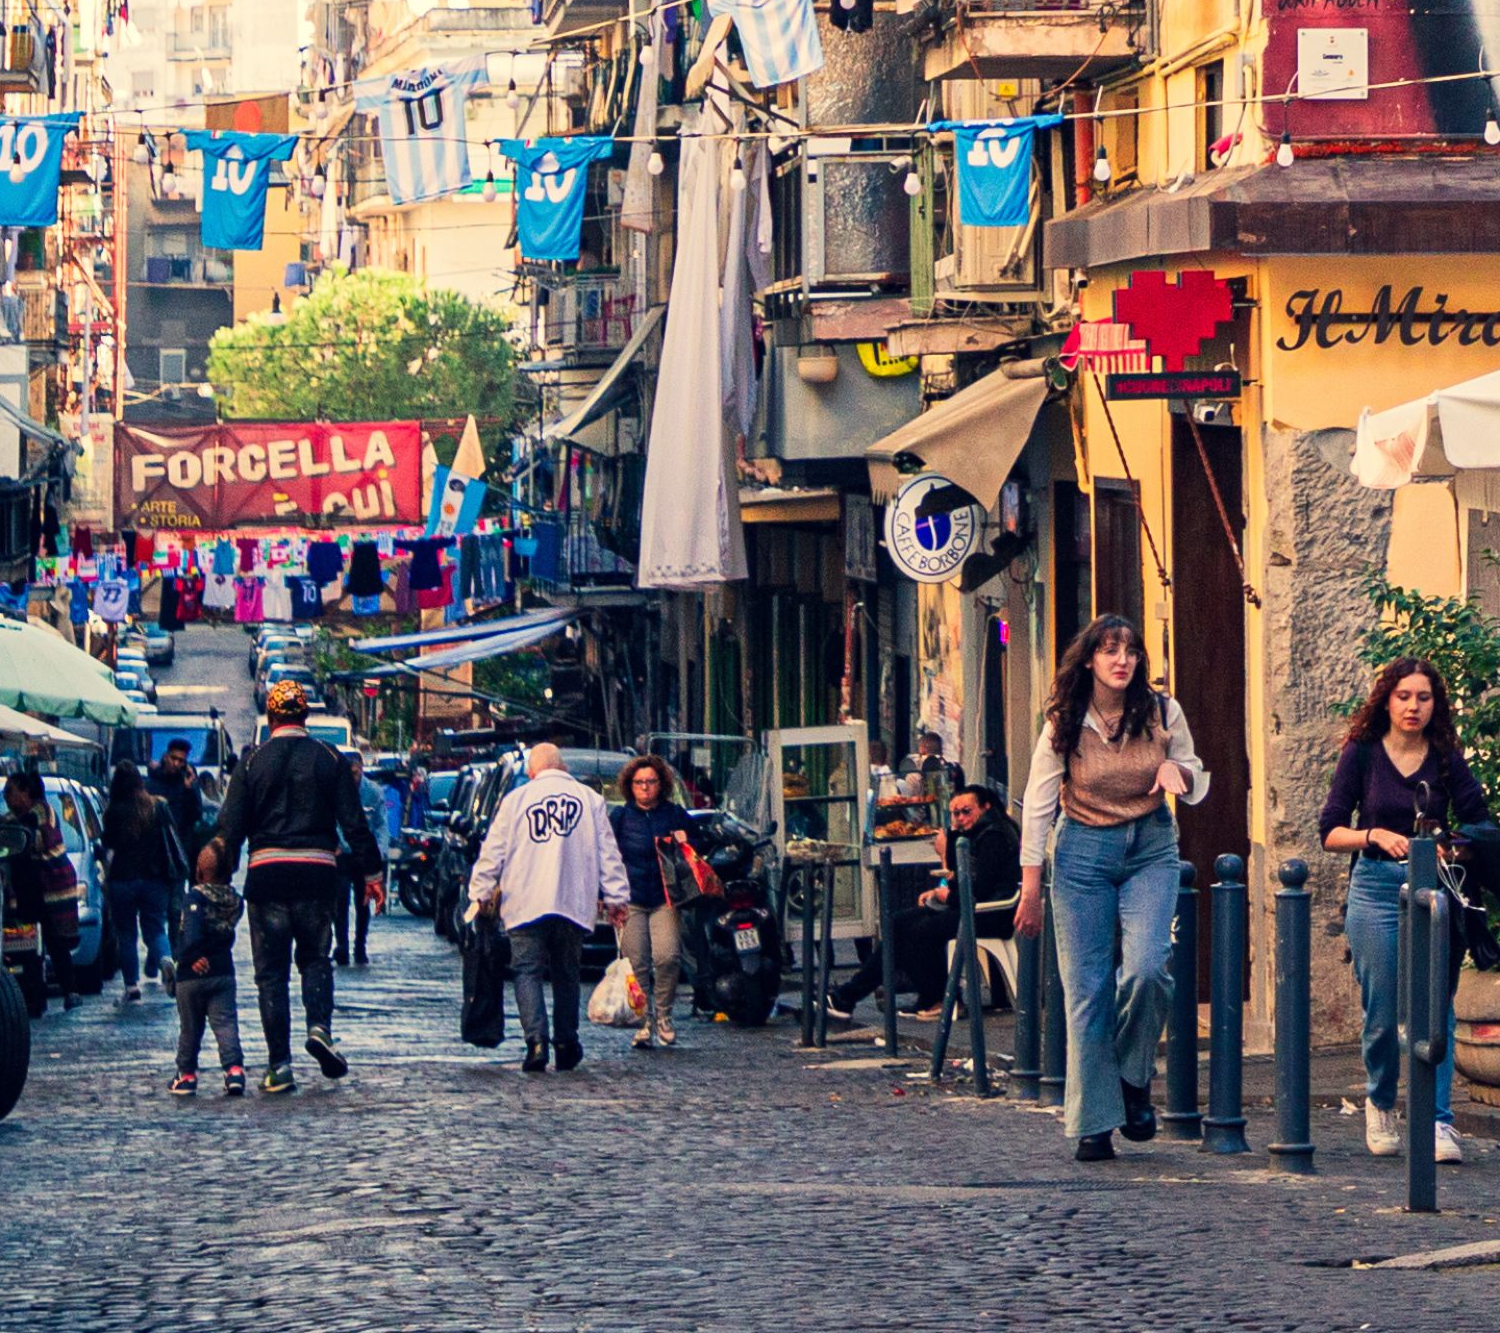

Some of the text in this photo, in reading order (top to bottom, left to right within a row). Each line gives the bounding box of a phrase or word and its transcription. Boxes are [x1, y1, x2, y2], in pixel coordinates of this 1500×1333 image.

[404, 89, 444, 136] 10
[966, 133, 1021, 168] 10
[210, 158, 258, 196] 10
[524, 167, 575, 203] 10
[129, 429, 397, 494] FORCELLA
[141, 500, 177, 514] ARTE
[149, 515, 202, 528] STORIA
[918, 510, 970, 571] BORBONE
[302, 584, 317, 603] 10
